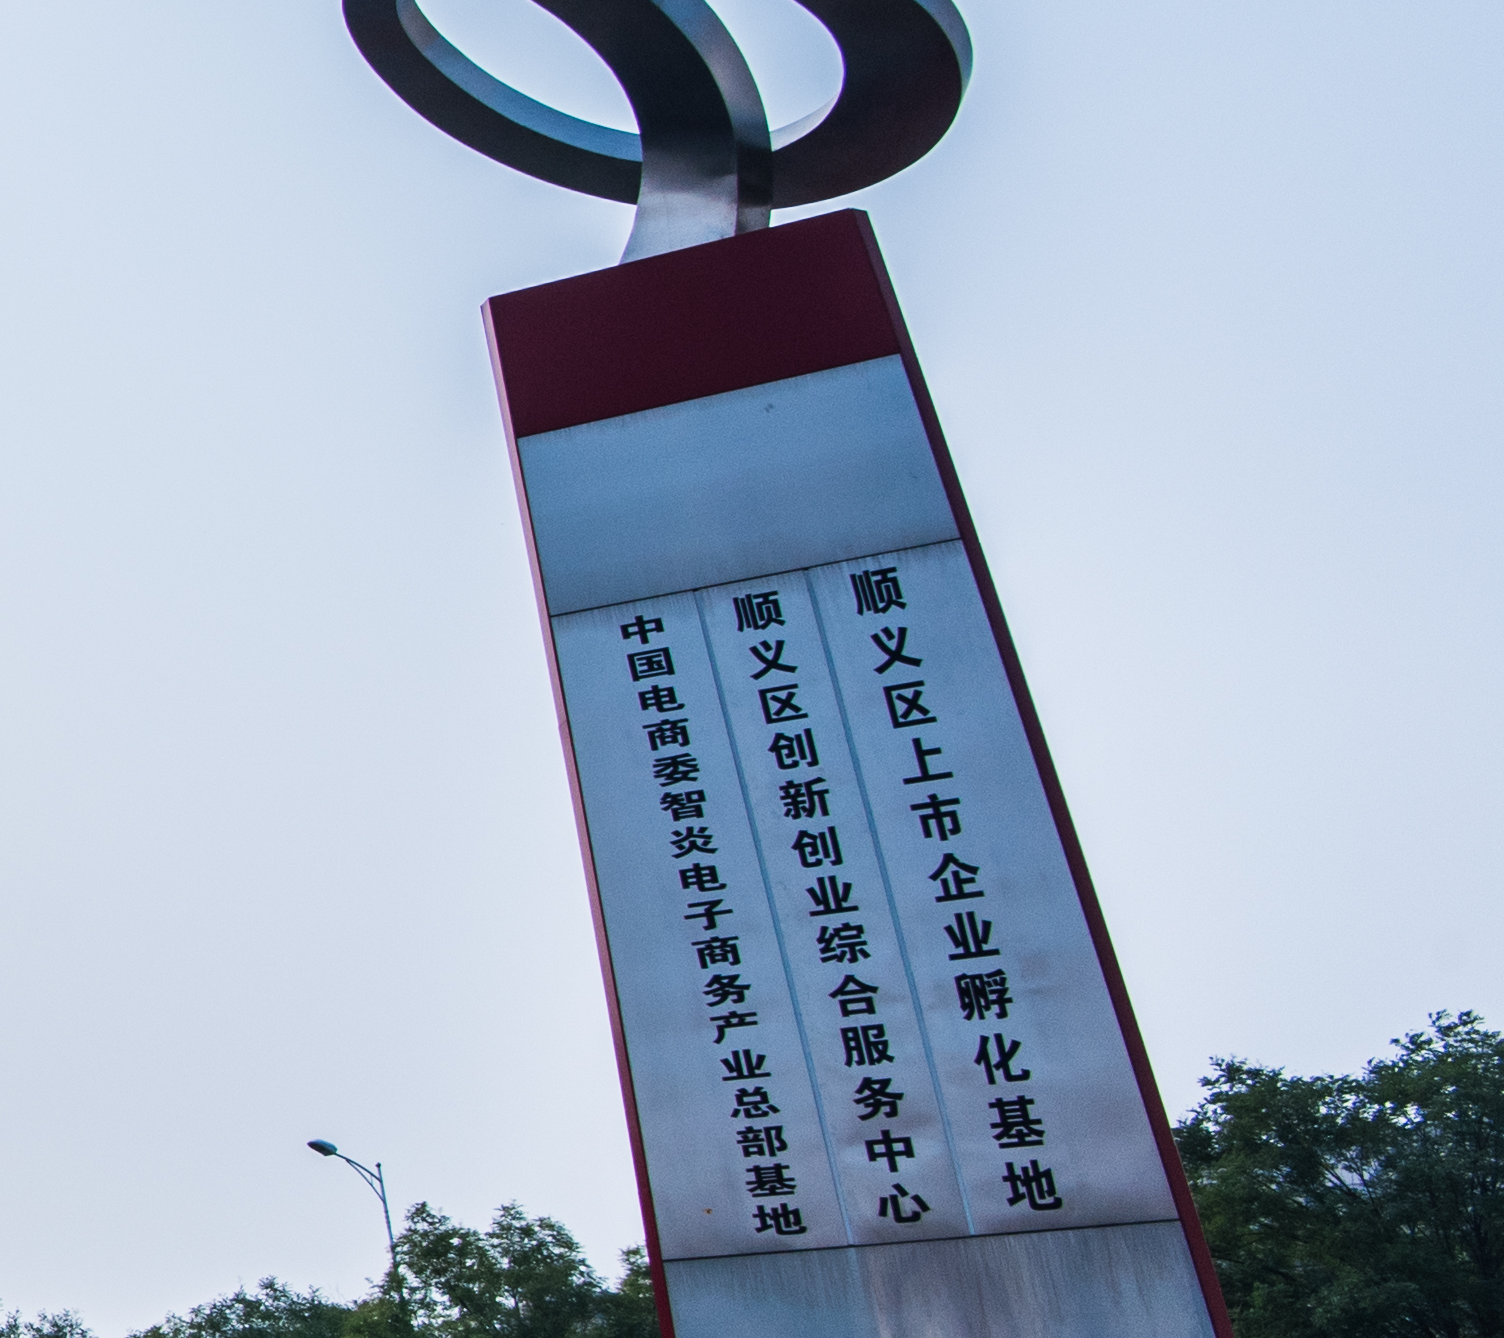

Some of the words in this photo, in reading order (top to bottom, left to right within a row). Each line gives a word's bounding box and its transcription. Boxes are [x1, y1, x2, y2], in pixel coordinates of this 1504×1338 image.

[732, 590, 931, 1224] 顺义区创新创业综合服务中心
[850, 566, 1063, 1213] 顺义区上市企业孵化基地
